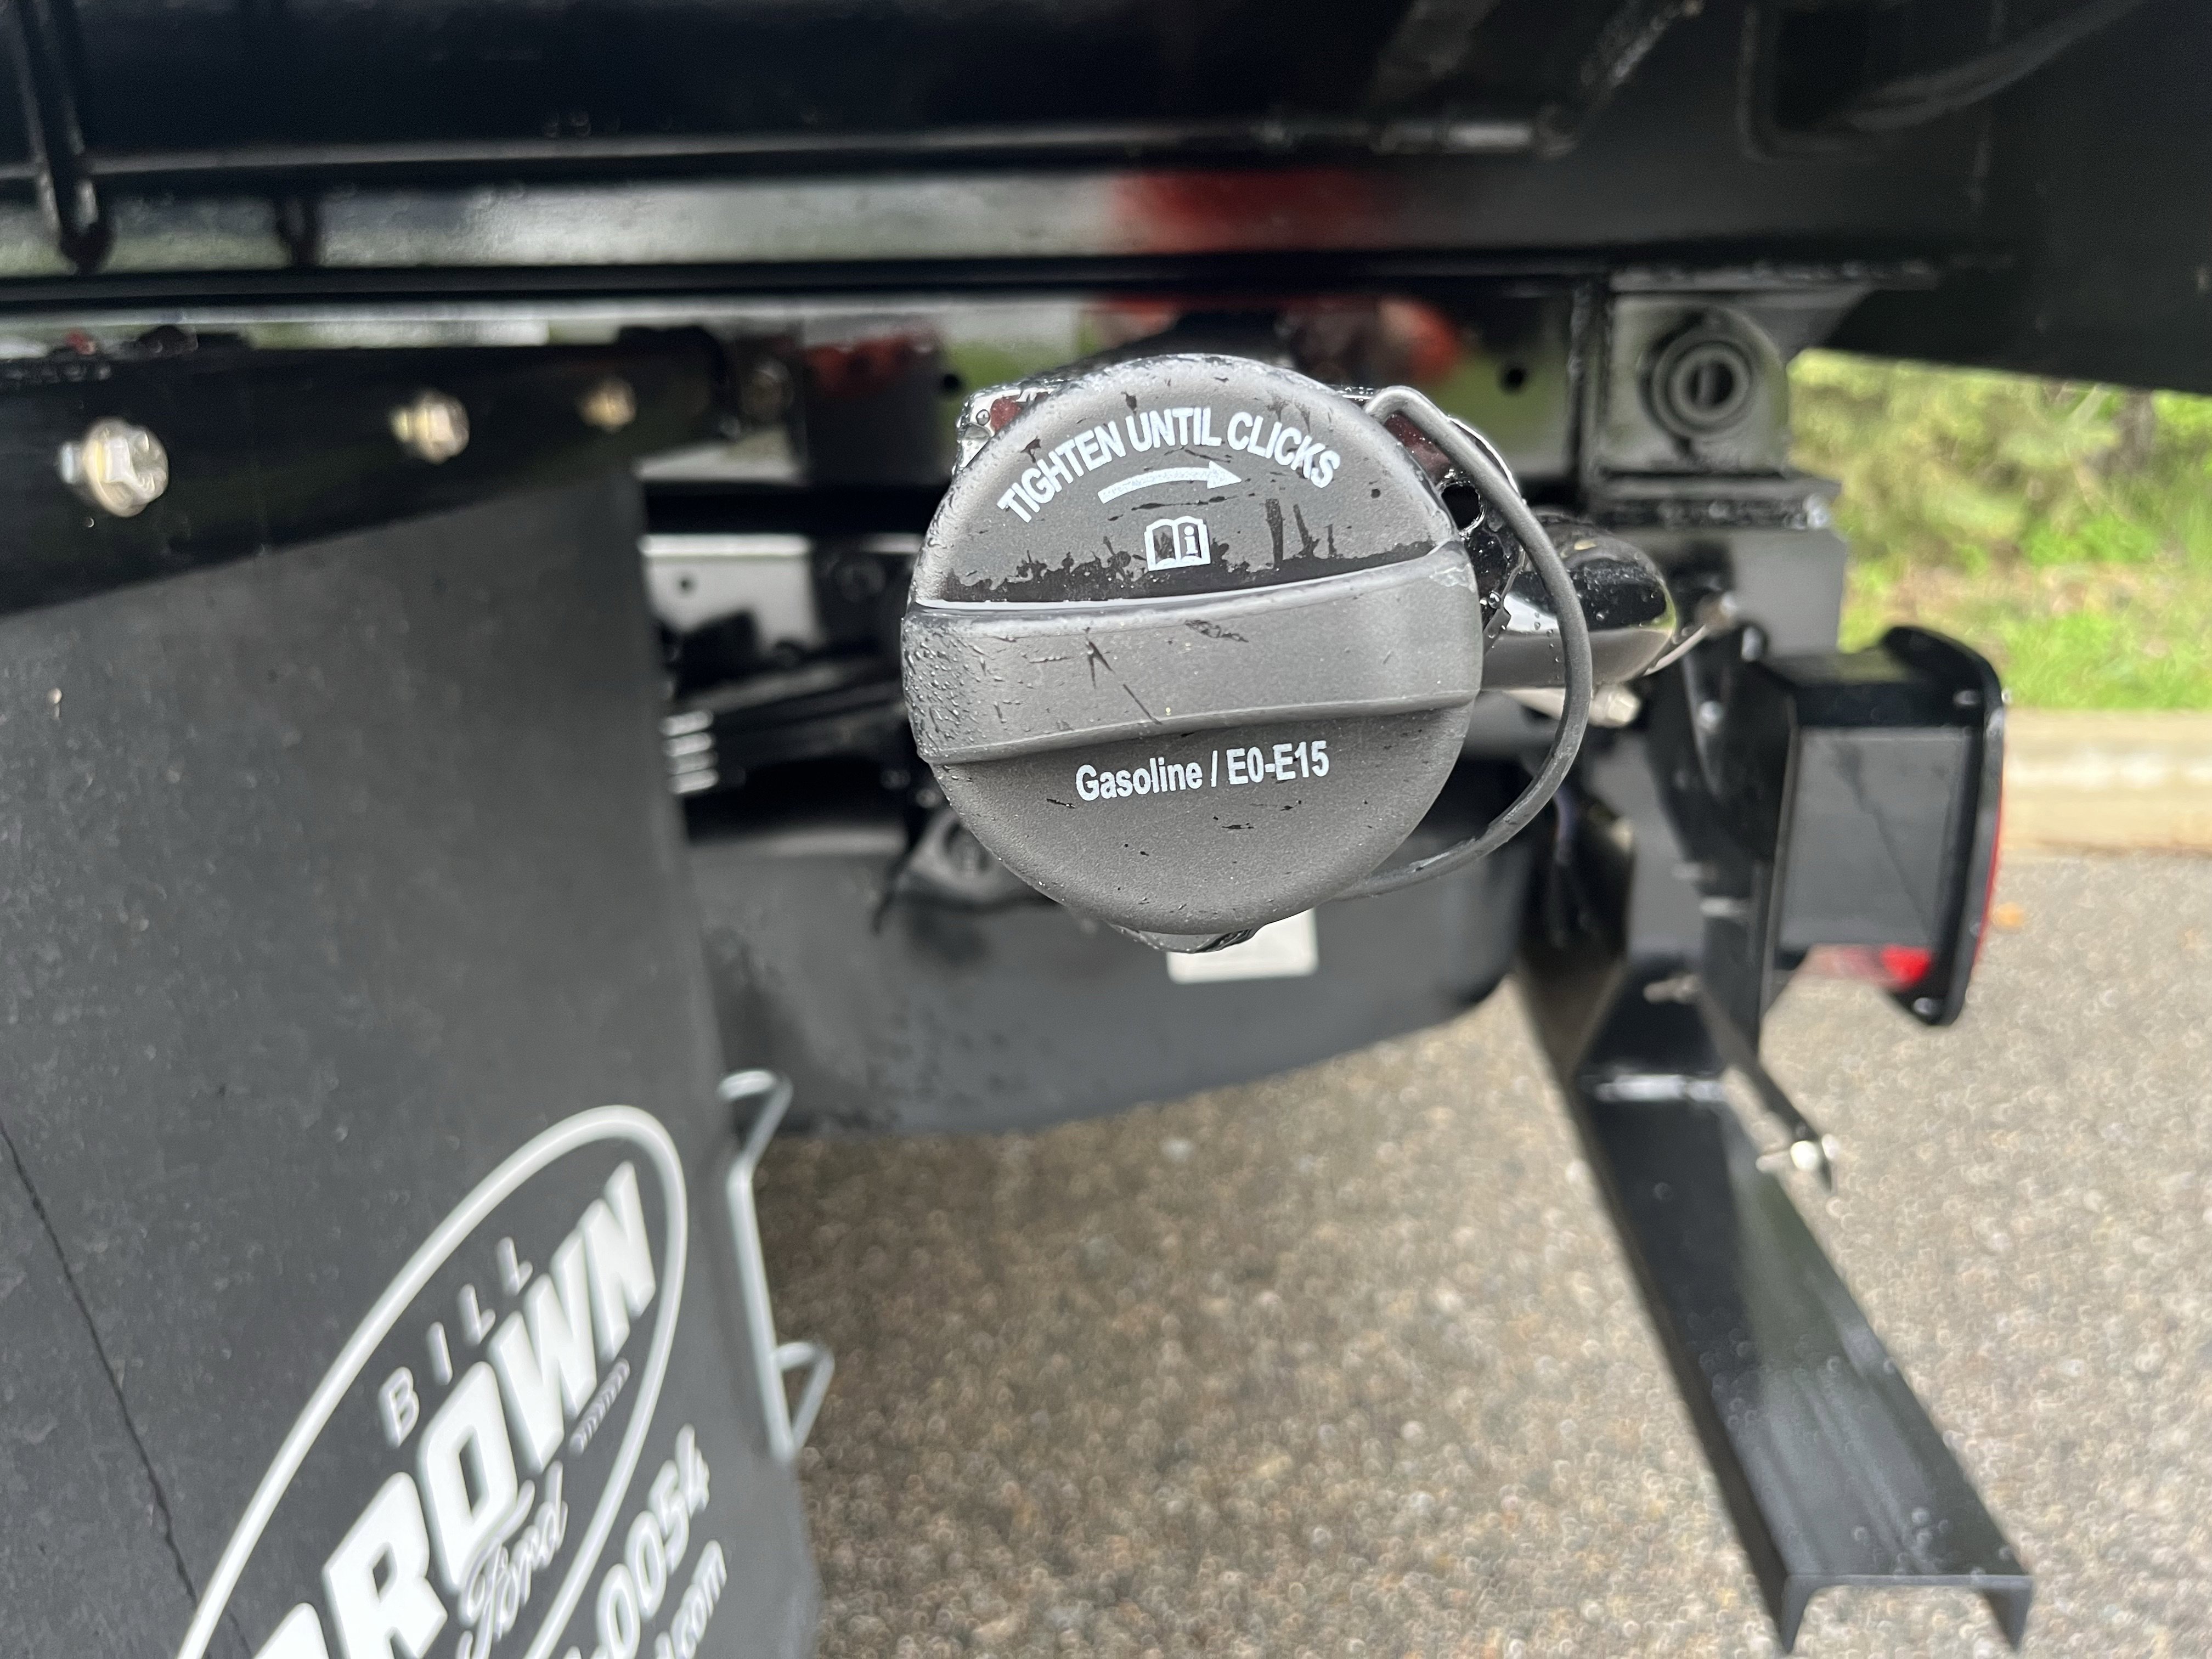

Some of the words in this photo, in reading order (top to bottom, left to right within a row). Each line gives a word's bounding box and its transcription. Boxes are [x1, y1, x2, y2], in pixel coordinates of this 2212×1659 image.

[996, 420, 1127, 523] TIGHTEN
[1125, 407, 1222, 453] UNTIL
[1227, 411, 1341, 489] CLICKS
[1075, 757, 1203, 802] Gasoline
[1210, 750, 1218, 787] /
[1226, 740, 1330, 786] E0-E15
[377, 1236, 533, 1448] BILL
